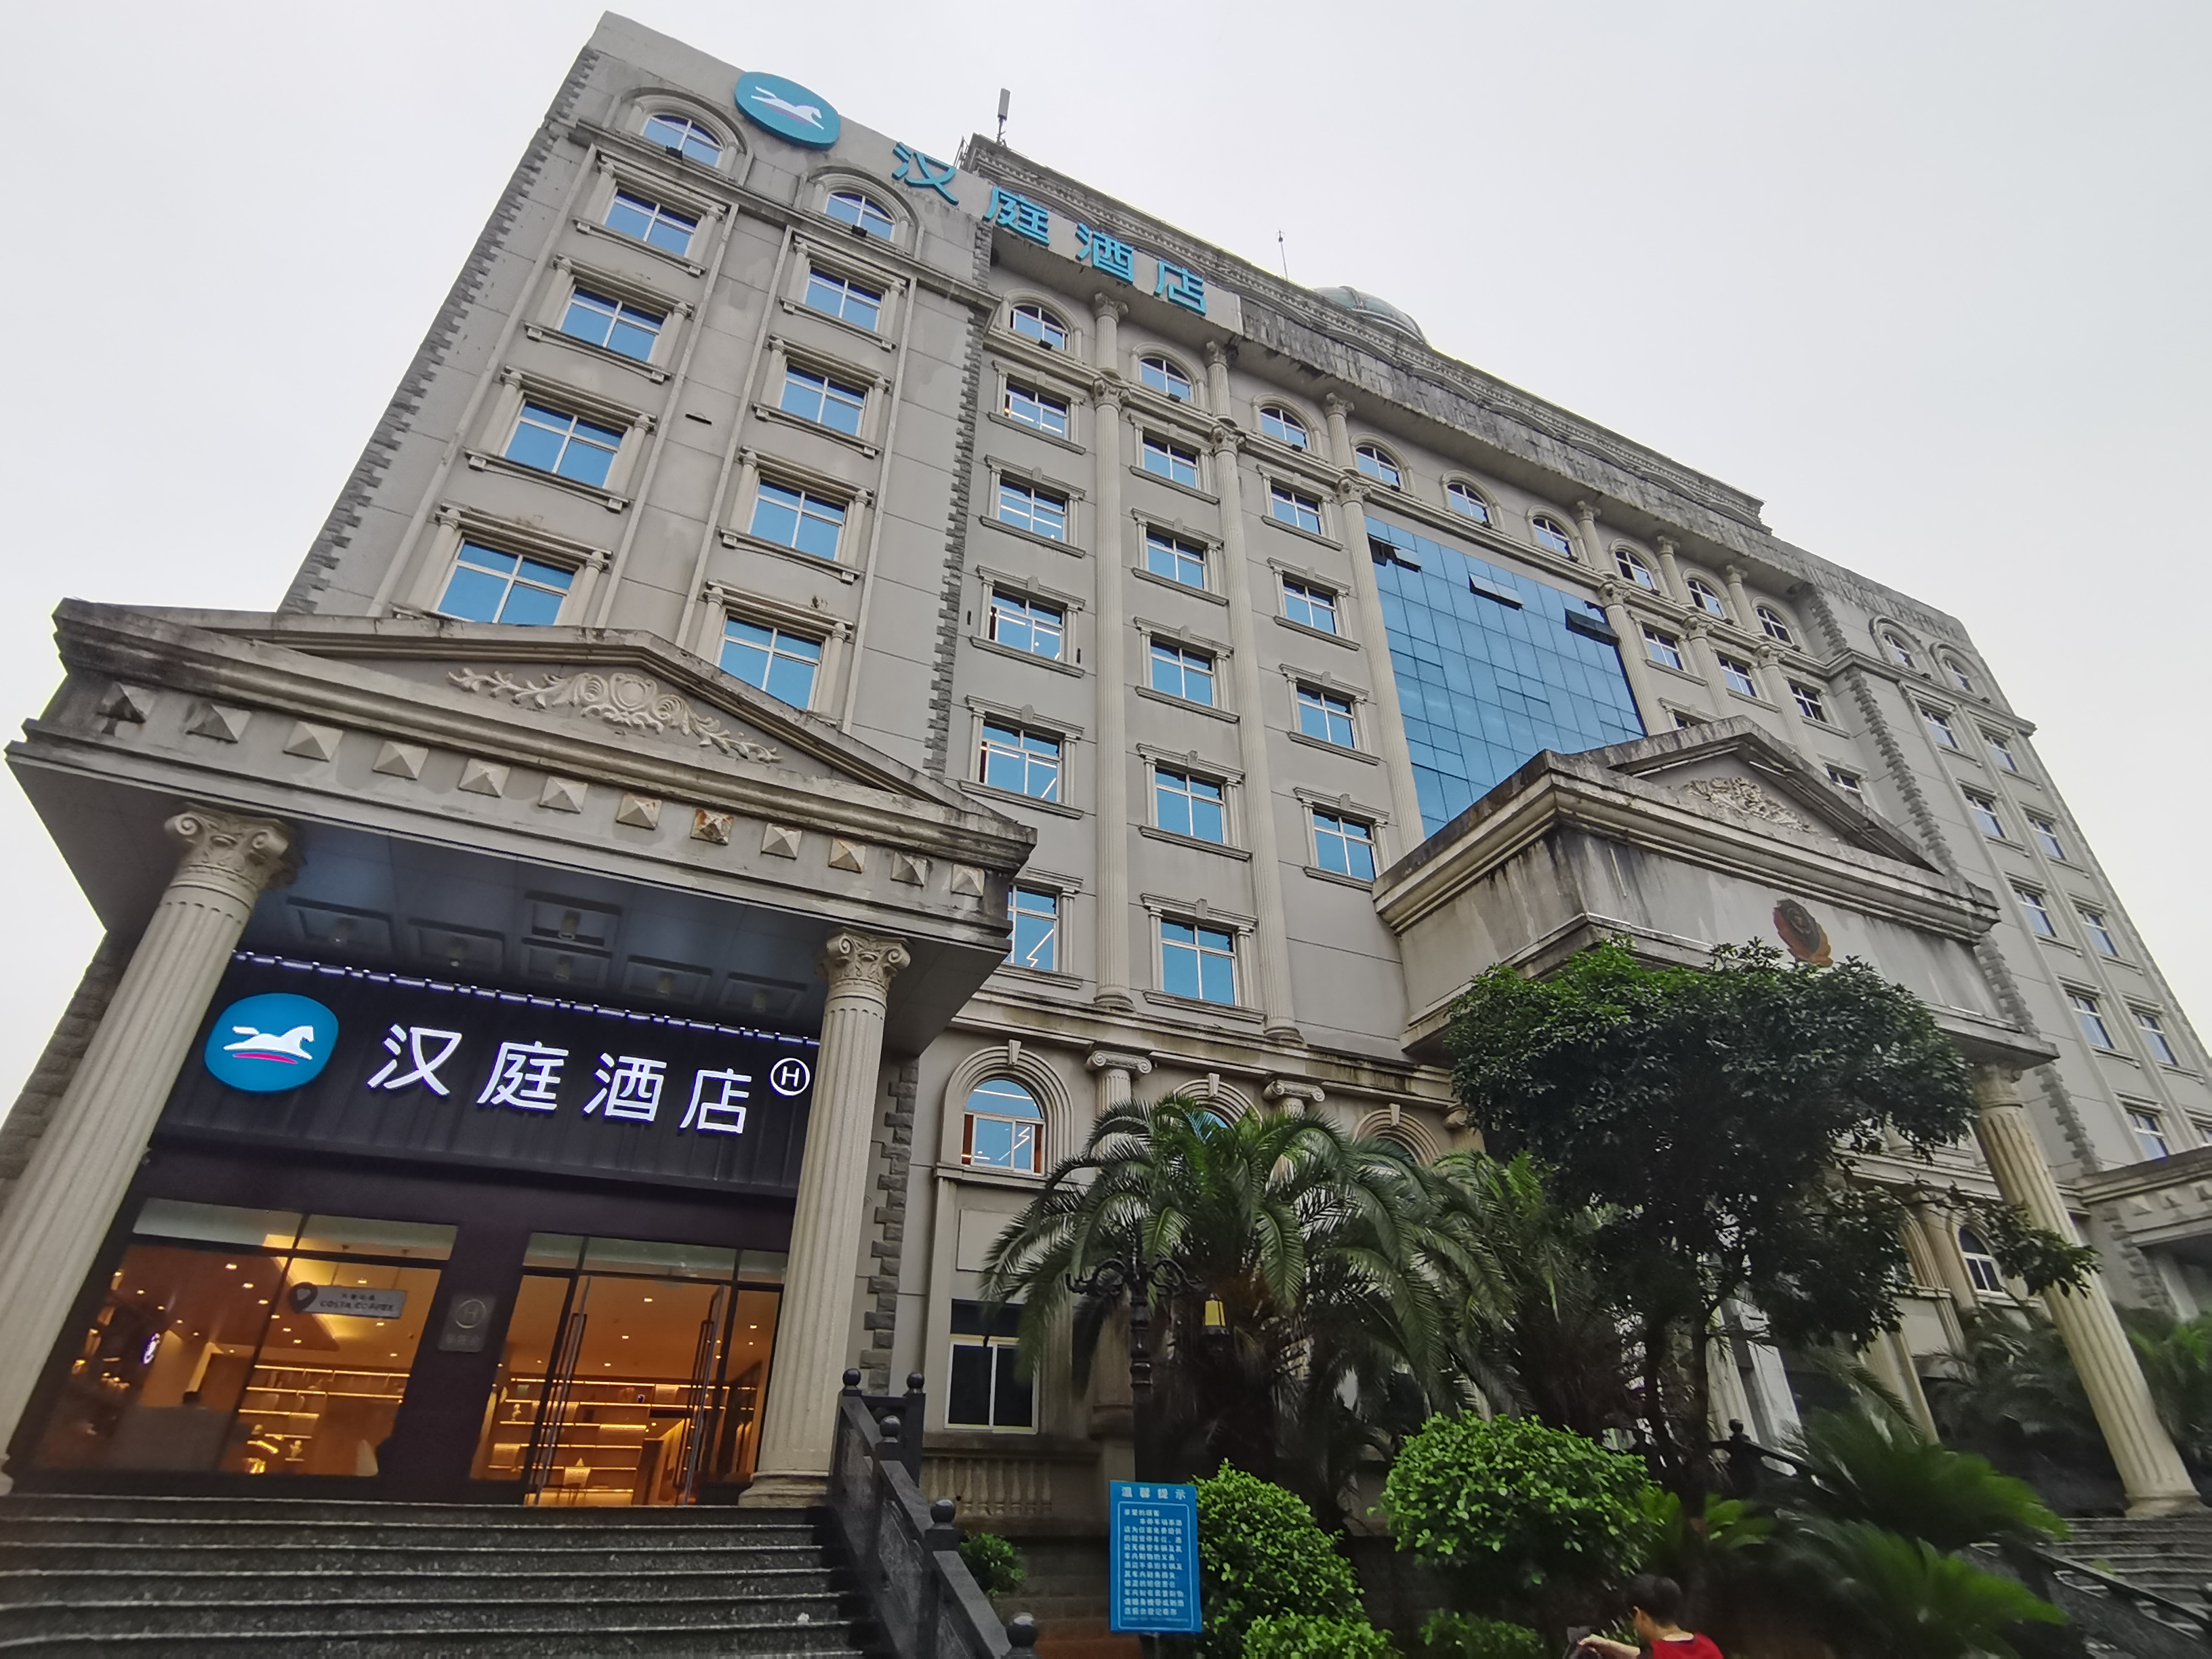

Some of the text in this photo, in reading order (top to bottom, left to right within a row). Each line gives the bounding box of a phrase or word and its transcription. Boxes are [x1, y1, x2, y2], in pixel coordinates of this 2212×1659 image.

[891, 140, 1208, 316] 汉庭酒店
[367, 1024, 752, 1134] 汉庭酒店
[1121, 1486, 1186, 1500] 温馨提示
